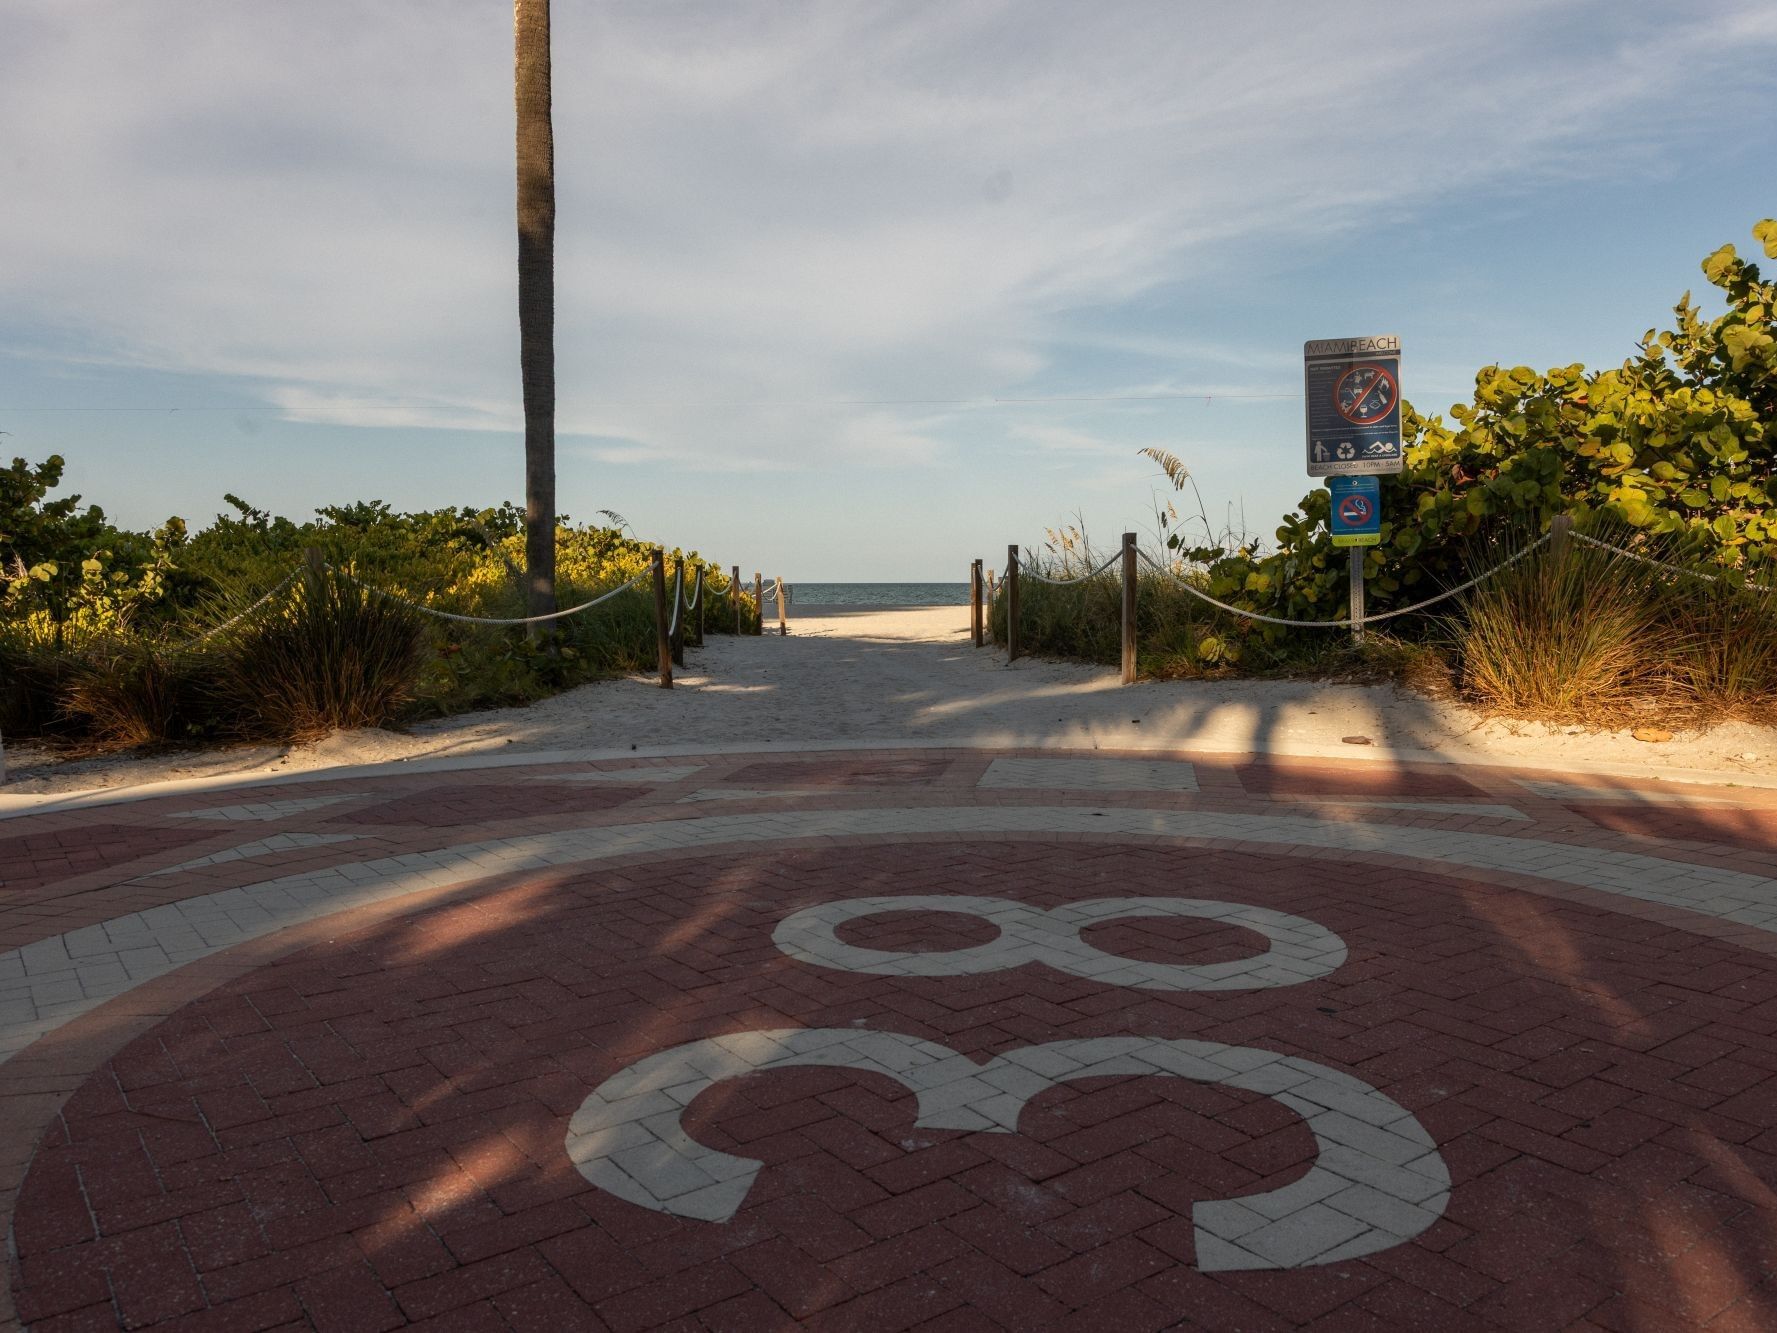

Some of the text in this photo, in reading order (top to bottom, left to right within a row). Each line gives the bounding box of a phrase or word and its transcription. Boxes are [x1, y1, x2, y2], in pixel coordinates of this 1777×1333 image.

[1333, 462, 1359, 470] CLOSED
[1363, 461, 1381, 469] 10PM
[1385, 459, 1400, 467] 5AM
